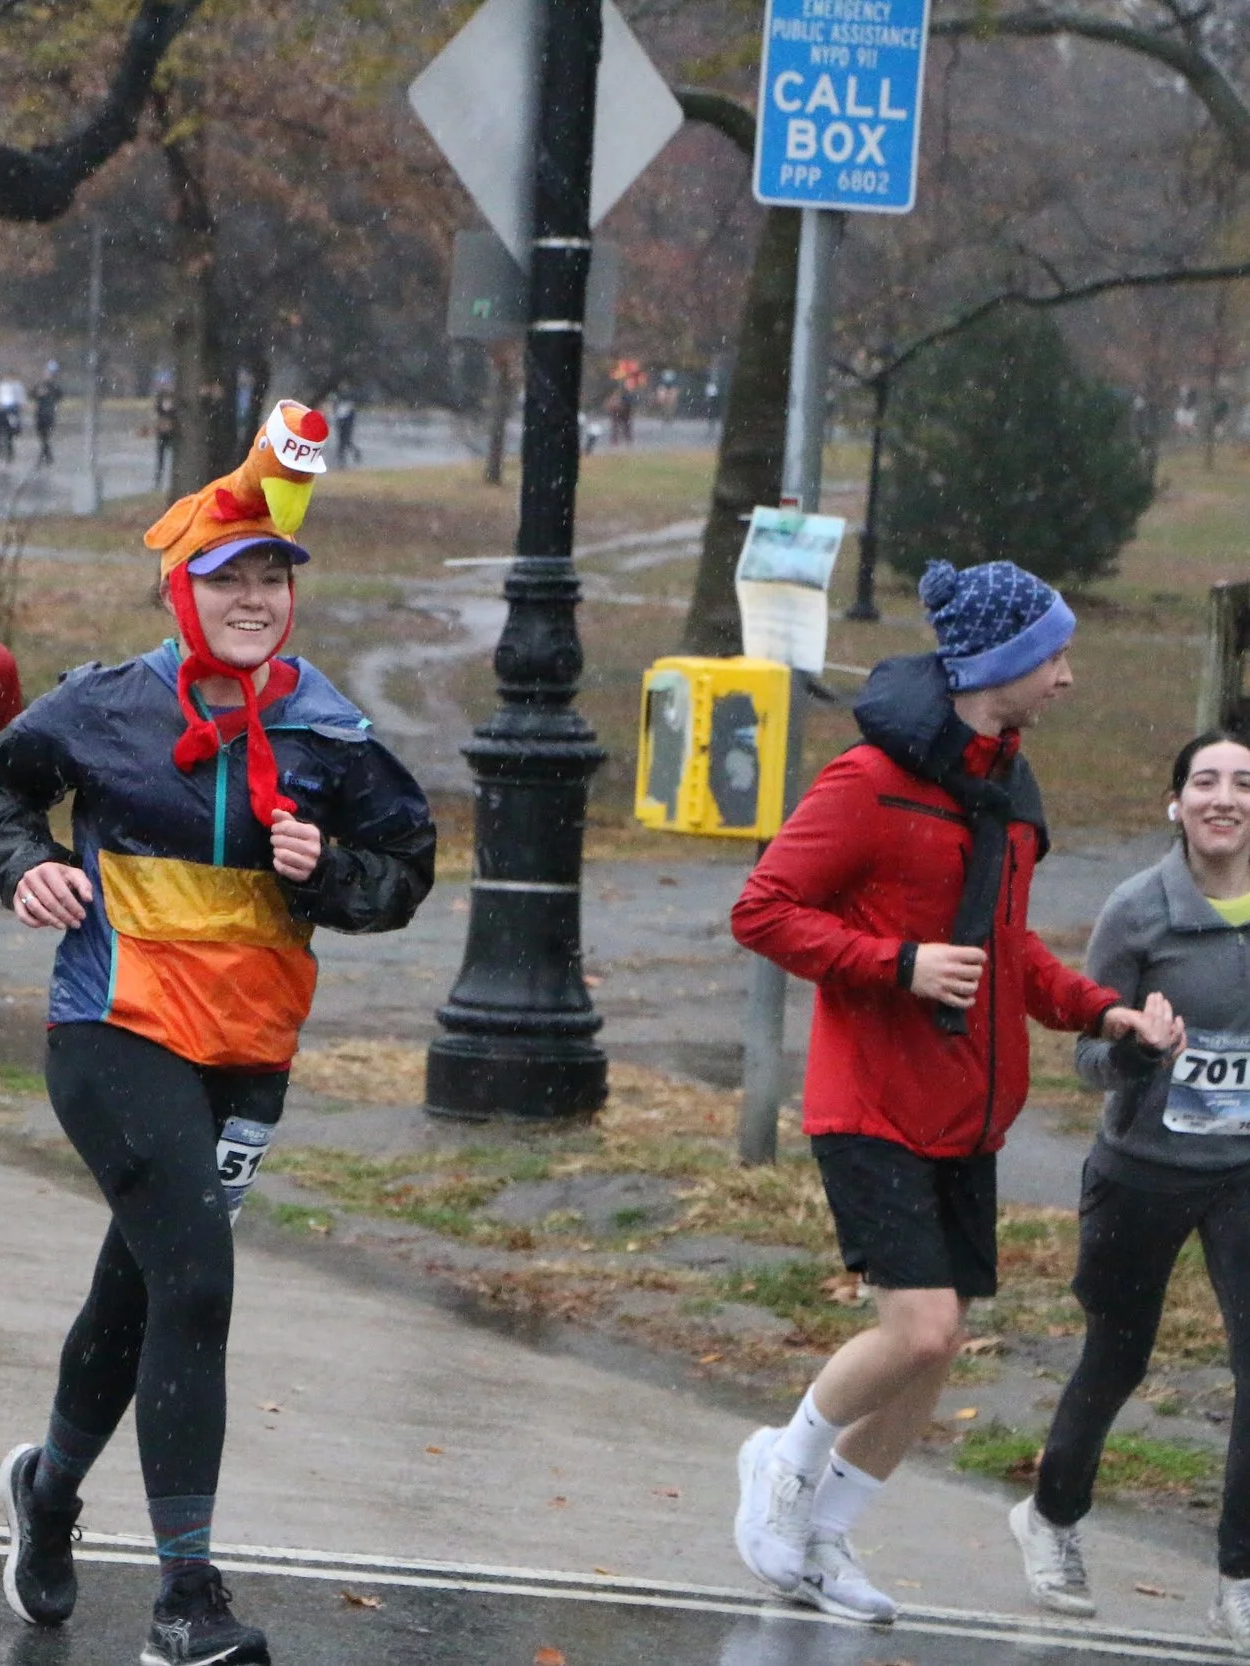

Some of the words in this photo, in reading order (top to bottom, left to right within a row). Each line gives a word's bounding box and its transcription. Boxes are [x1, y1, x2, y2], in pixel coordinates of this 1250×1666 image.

[802, 0, 892, 21] EMERGENCY
[771, 18, 825, 42] PUBLIC
[831, 24, 920, 49] ASSISTANCE
[810, 45, 849, 67] NYPD
[857, 47, 878, 68] 911
[773, 70, 907, 120] CALL
[786, 118, 886, 166] BOX
[780, 164, 822, 188] PPP
[837, 169, 890, 194] 6802
[282, 438, 322, 463] PPT
